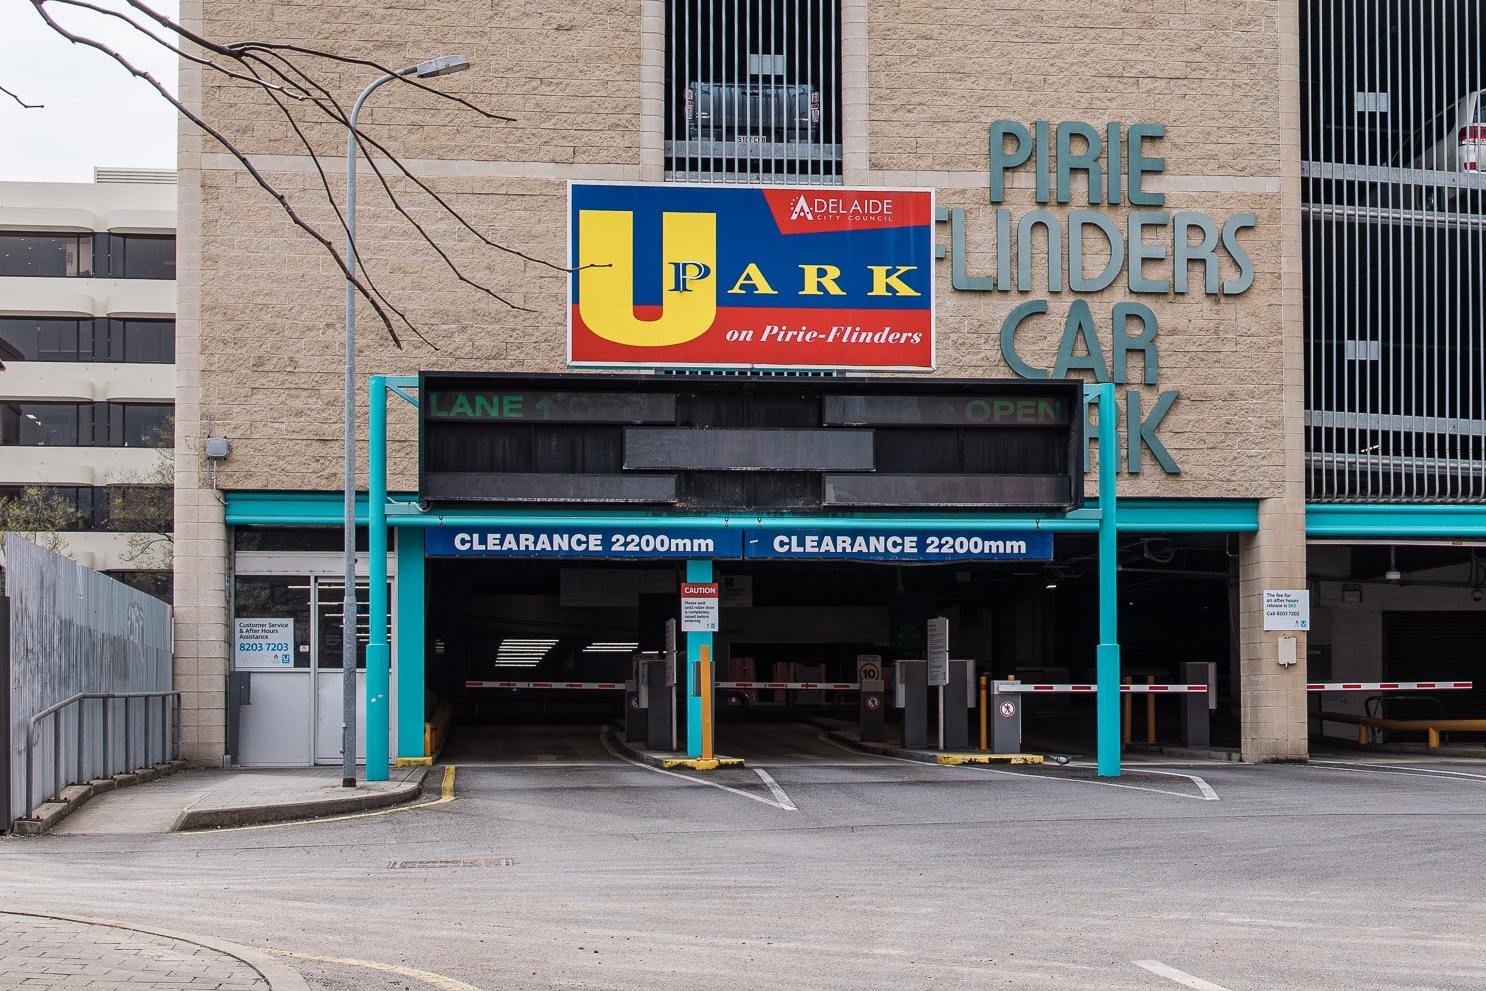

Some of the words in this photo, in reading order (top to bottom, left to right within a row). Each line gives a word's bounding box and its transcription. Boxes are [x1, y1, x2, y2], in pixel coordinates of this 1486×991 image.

[990, 120, 1165, 205] PIRIE
[791, 194, 893, 220] ADELAIDE
[726, 328, 754, 342] on
[760, 325, 923, 344] Pirie-Flinders
[1000, 299, 1158, 385] CAR
[430, 394, 524, 418] LANE
[964, 400, 1062, 423] OPEN
[1083, 390, 1182, 475] RK
[454, 532, 603, 552] CLEARANCE
[610, 533, 715, 553] 2200mm
[773, 535, 918, 553] CLEARANCE
[925, 536, 1027, 554] 2200mm
[239, 642, 264, 652] 8203
[265, 642, 289, 652] 7203
[862, 668, 876, 679] 10
